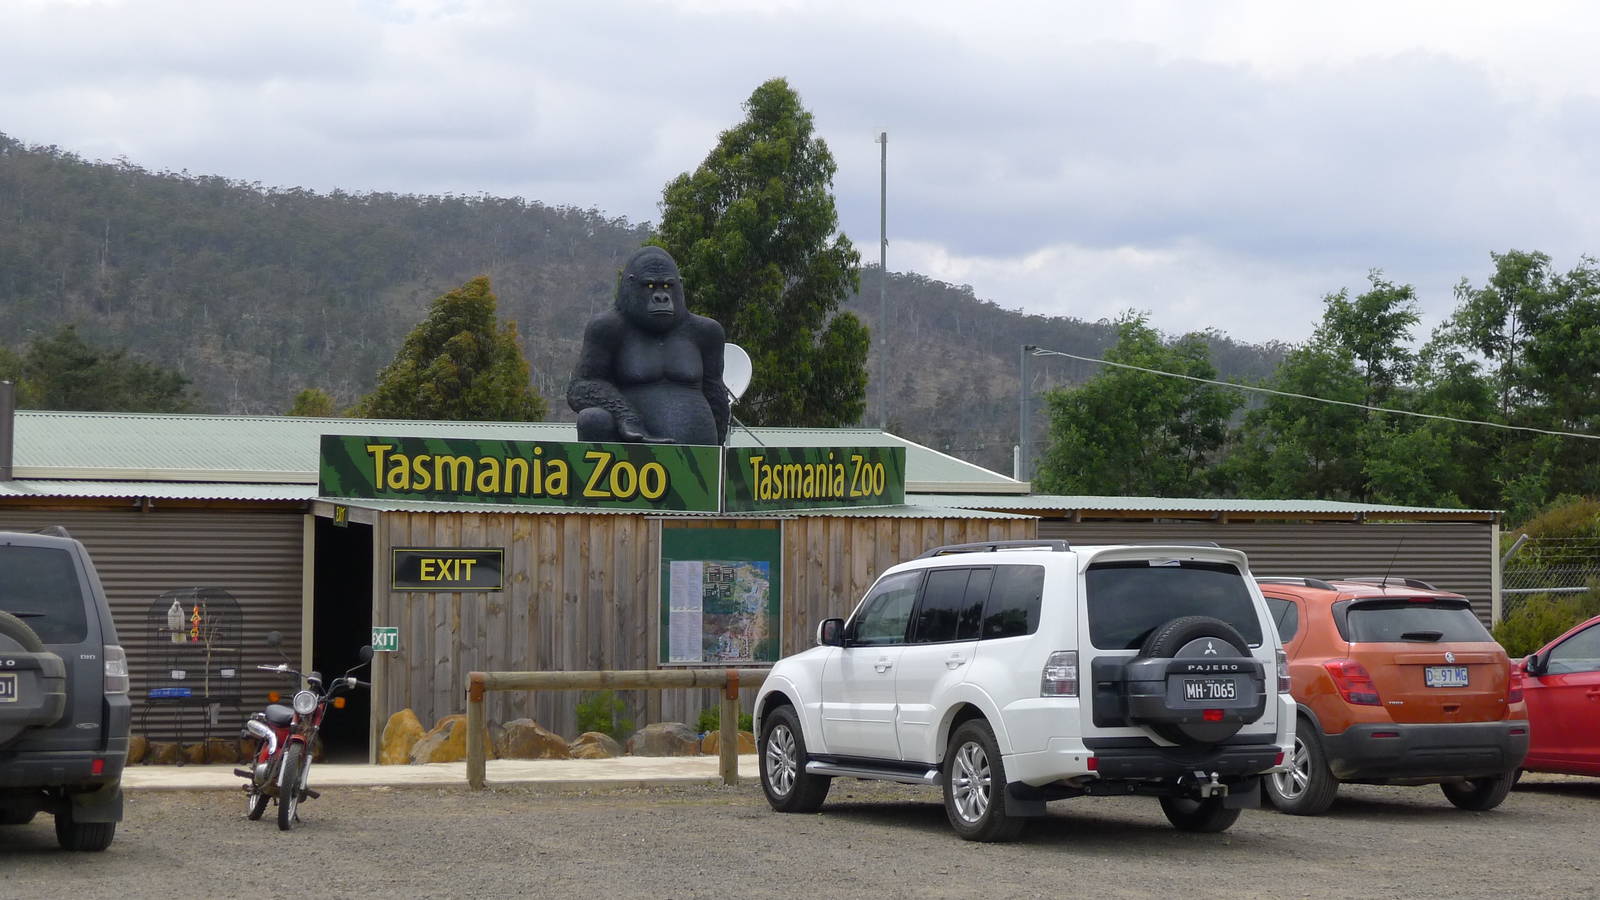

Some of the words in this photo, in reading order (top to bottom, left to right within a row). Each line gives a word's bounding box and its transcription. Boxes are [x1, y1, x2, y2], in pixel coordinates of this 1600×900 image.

[367, 445, 568, 495] Tasmania
[582, 451, 667, 499] Zoo
[750, 452, 845, 500] Tasmania
[850, 455, 885, 497] Zoo
[420, 559, 477, 581] EXIT
